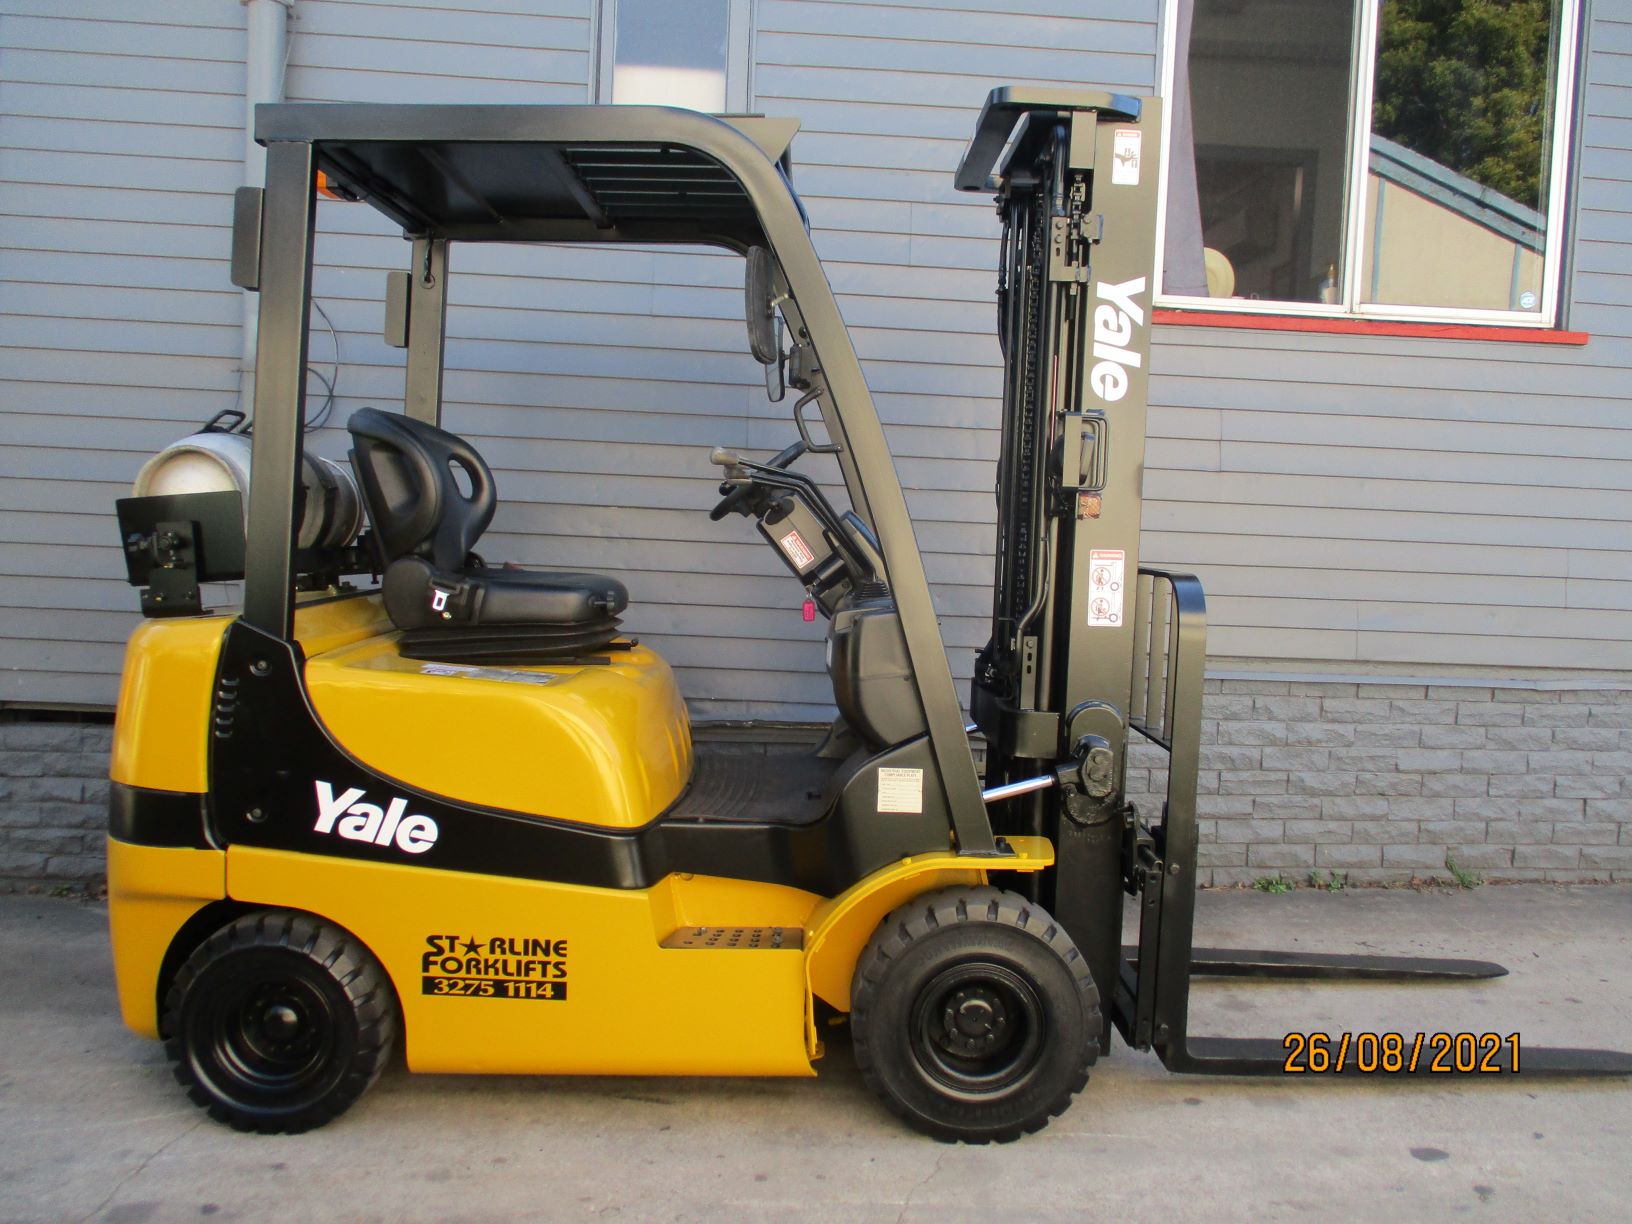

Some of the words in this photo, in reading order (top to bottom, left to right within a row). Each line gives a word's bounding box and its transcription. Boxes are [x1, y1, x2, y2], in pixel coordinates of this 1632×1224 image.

[1091, 276, 1146, 402] Yale
[313, 780, 439, 854] Yale
[422, 951, 567, 979] FORKLIFTS
[433, 979, 495, 996] 3275
[504, 981, 554, 998] 1114
